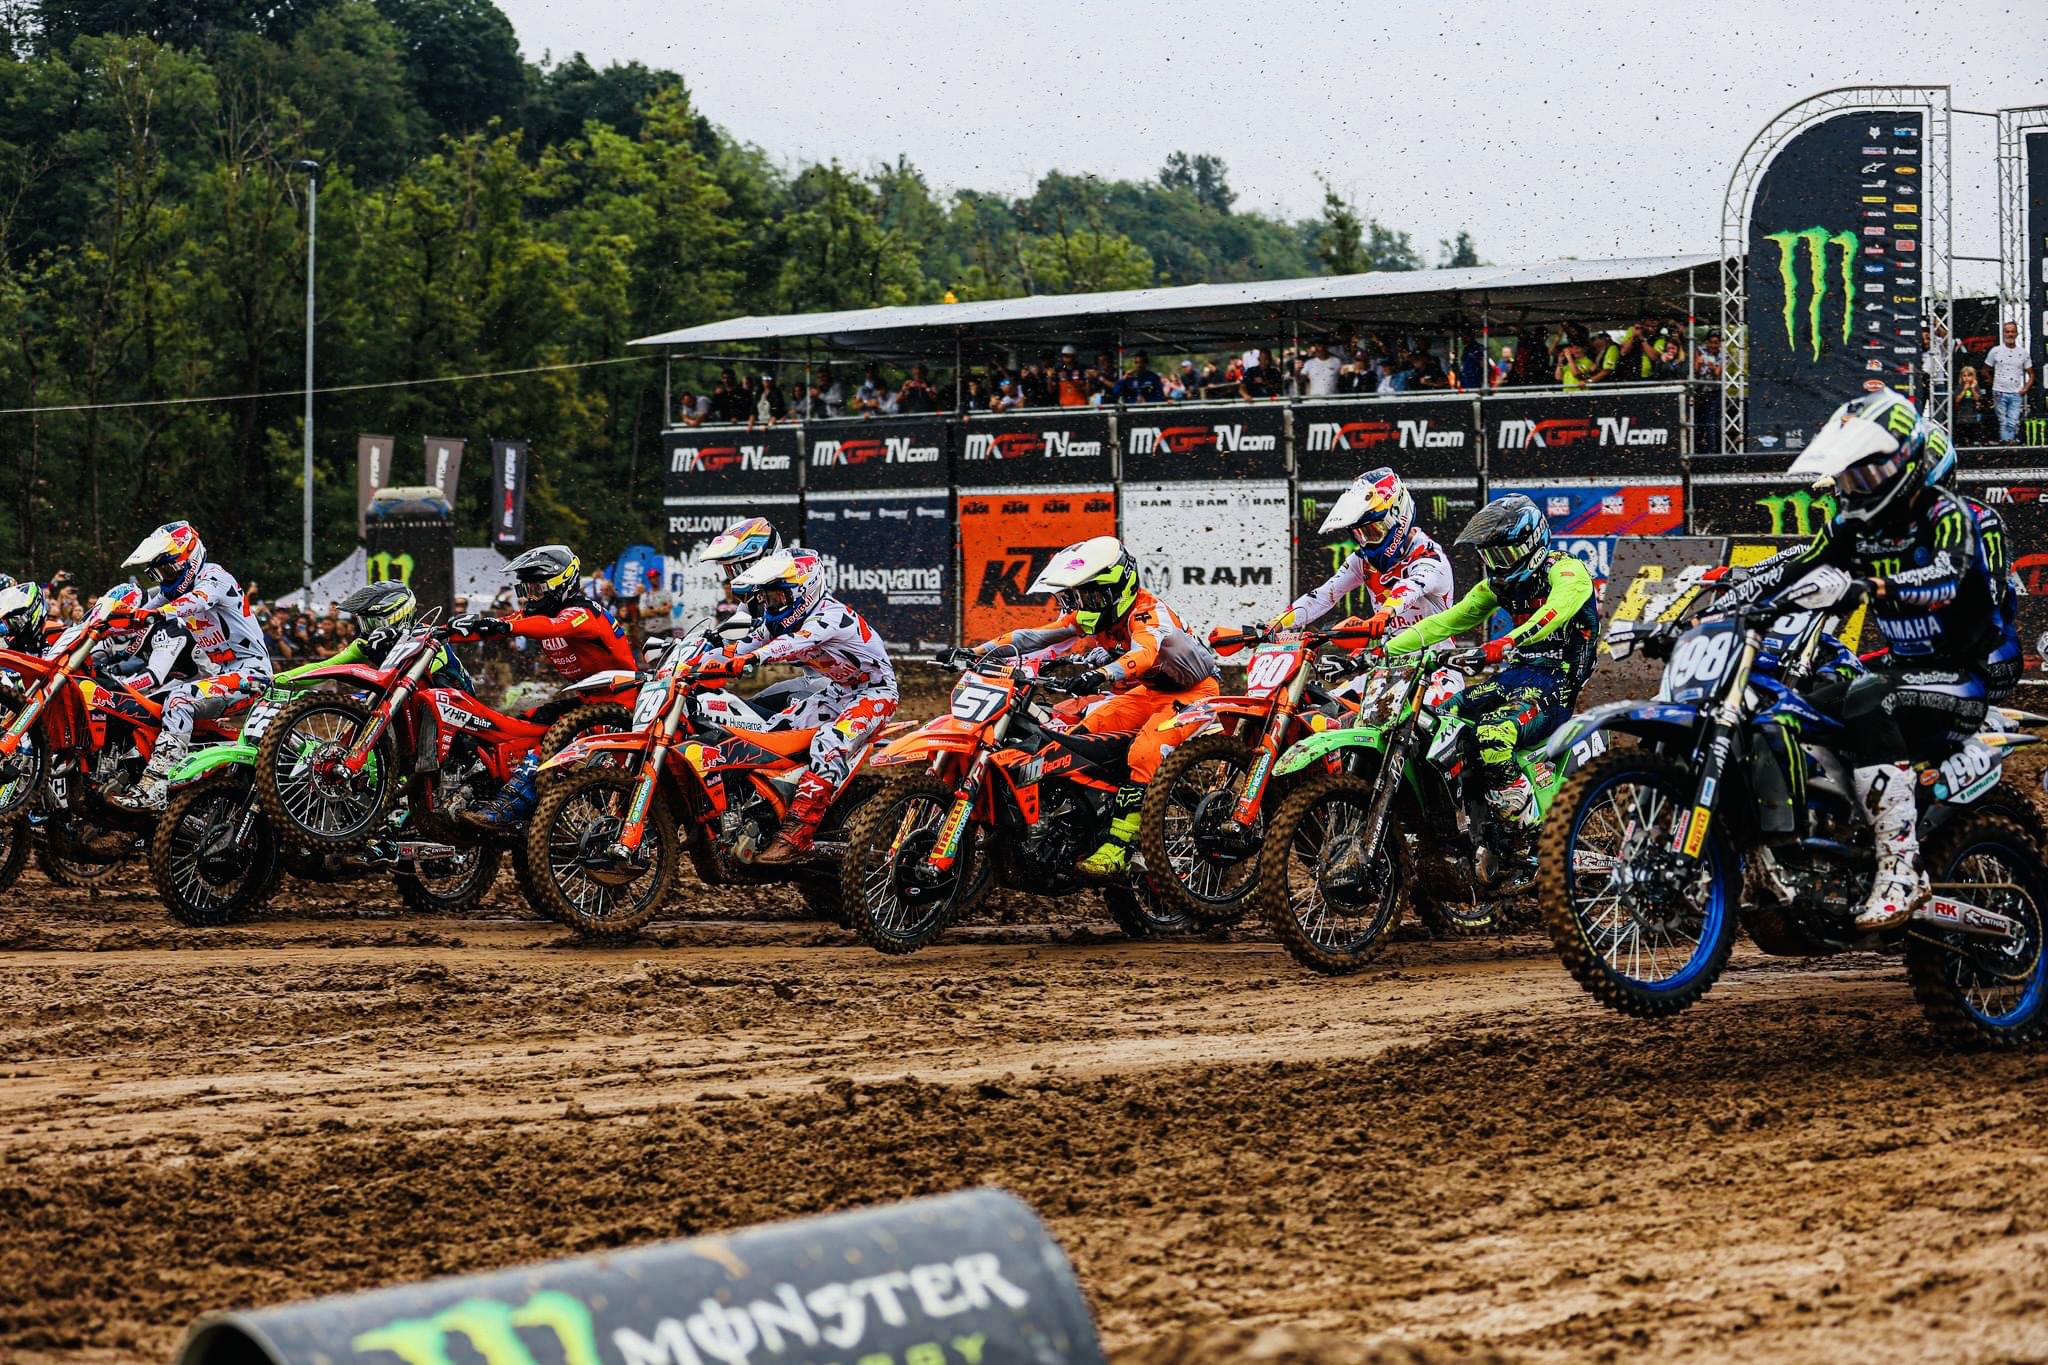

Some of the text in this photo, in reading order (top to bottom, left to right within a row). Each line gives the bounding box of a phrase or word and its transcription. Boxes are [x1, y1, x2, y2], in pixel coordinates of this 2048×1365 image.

[1140, 498, 1287, 507] RAM RAM RAM
[669, 517, 724, 532] FOLLOW
[1384, 514, 1409, 558] RedBull
[177, 560, 198, 594] RedBull
[840, 564, 941, 594] Husqvarna
[1183, 567, 1272, 586] RAM
[780, 594, 814, 630] RedBull
[1877, 614, 1942, 640] YAMAHA
[1249, 652, 1294, 689] 80
[443, 706, 467, 723] VHR
[634, 688, 667, 724] 79
[953, 687, 1005, 722] 51
[729, 717, 763, 731] Husqvarna
[1041, 752, 1072, 775] Racing
[1939, 744, 1991, 795] 198
[933, 802, 964, 855] PIRELLI
[952, 804, 973, 844] MOTOREX
[1934, 902, 1957, 918] RK
[613, 1252, 1029, 1365] MONSTER
